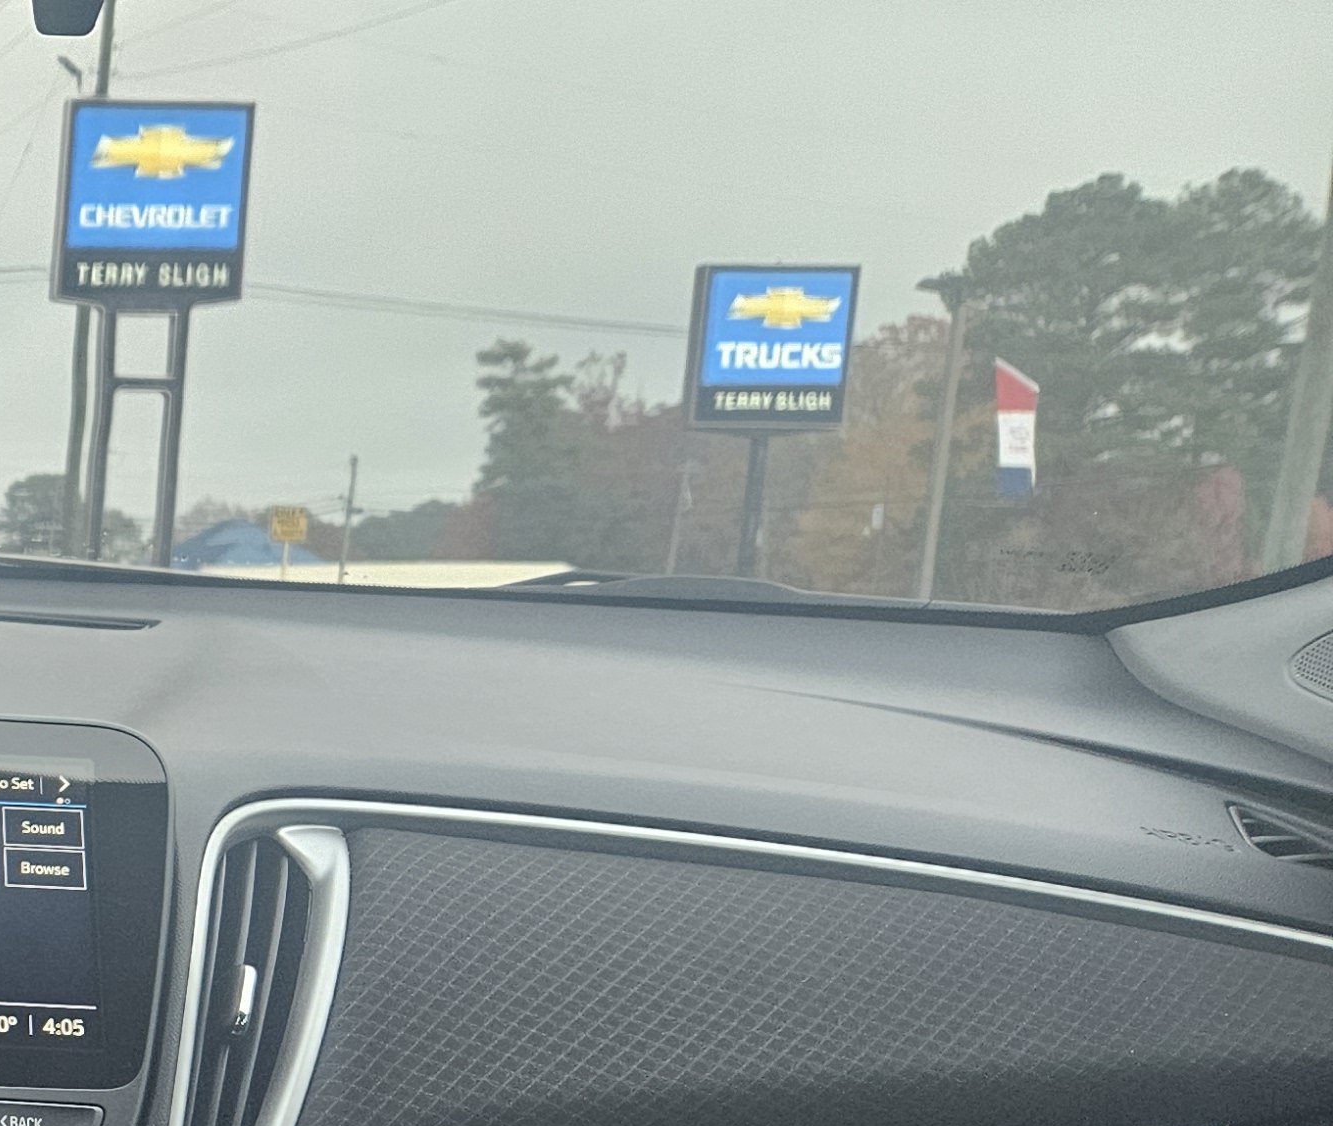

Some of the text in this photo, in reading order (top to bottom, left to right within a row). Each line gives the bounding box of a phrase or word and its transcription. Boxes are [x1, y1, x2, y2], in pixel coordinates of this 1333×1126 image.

[79, 204, 232, 229] CHEVROLET
[76, 262, 229, 287] TERRY SLIGH
[717, 341, 843, 369] TRUCKS
[714, 391, 832, 411] TERRY SLIGH
[11, 776, 35, 791] Set
[21, 820, 65, 835] Sound
[20, 860, 70, 876] Browse
[42, 1018, 85, 1036] 4:05
